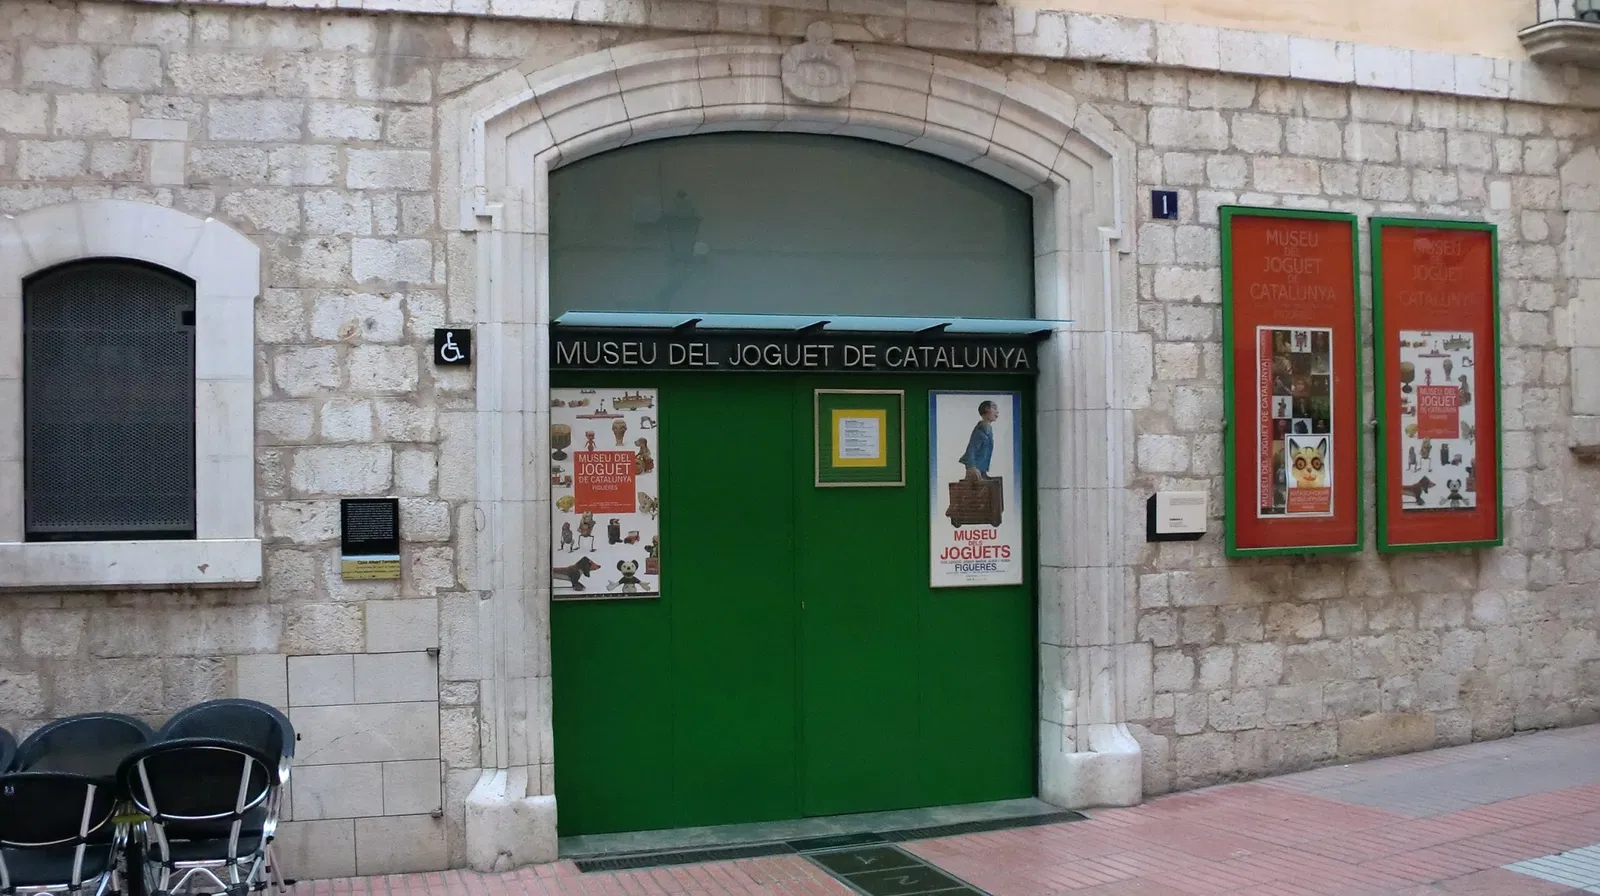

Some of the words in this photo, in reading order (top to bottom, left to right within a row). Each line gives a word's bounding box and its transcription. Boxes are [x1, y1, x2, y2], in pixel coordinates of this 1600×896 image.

[1162, 195, 1168, 214] 1
[1266, 228, 1318, 247] MUSEU
[1263, 256, 1322, 274] JOGUET
[1250, 282, 1337, 301] CATALUNYA
[556, 341, 657, 365] MUSEU
[669, 343, 719, 366] DEL
[729, 343, 834, 367] JOGUET
[844, 345, 876, 367] DE
[885, 346, 1031, 369] CATALUNYA
[1261, 361, 1269, 409] CATALUNYA
[1420, 396, 1456, 406] JOGUET
[1261, 411, 1269, 422] DE
[1261, 425, 1269, 457] JOGUET
[578, 454, 611, 463] MUSEU
[614, 453, 631, 462] DEL
[579, 463, 631, 475] JOGUET
[1261, 459, 1269, 475] DEL
[590, 475, 632, 483] CATALUNYA
[1261, 476, 1269, 508] MUSEU
[954, 529, 997, 541] MUSEU
[940, 545, 1011, 560] JOGUETS
[955, 563, 997, 572] FIGUERES
